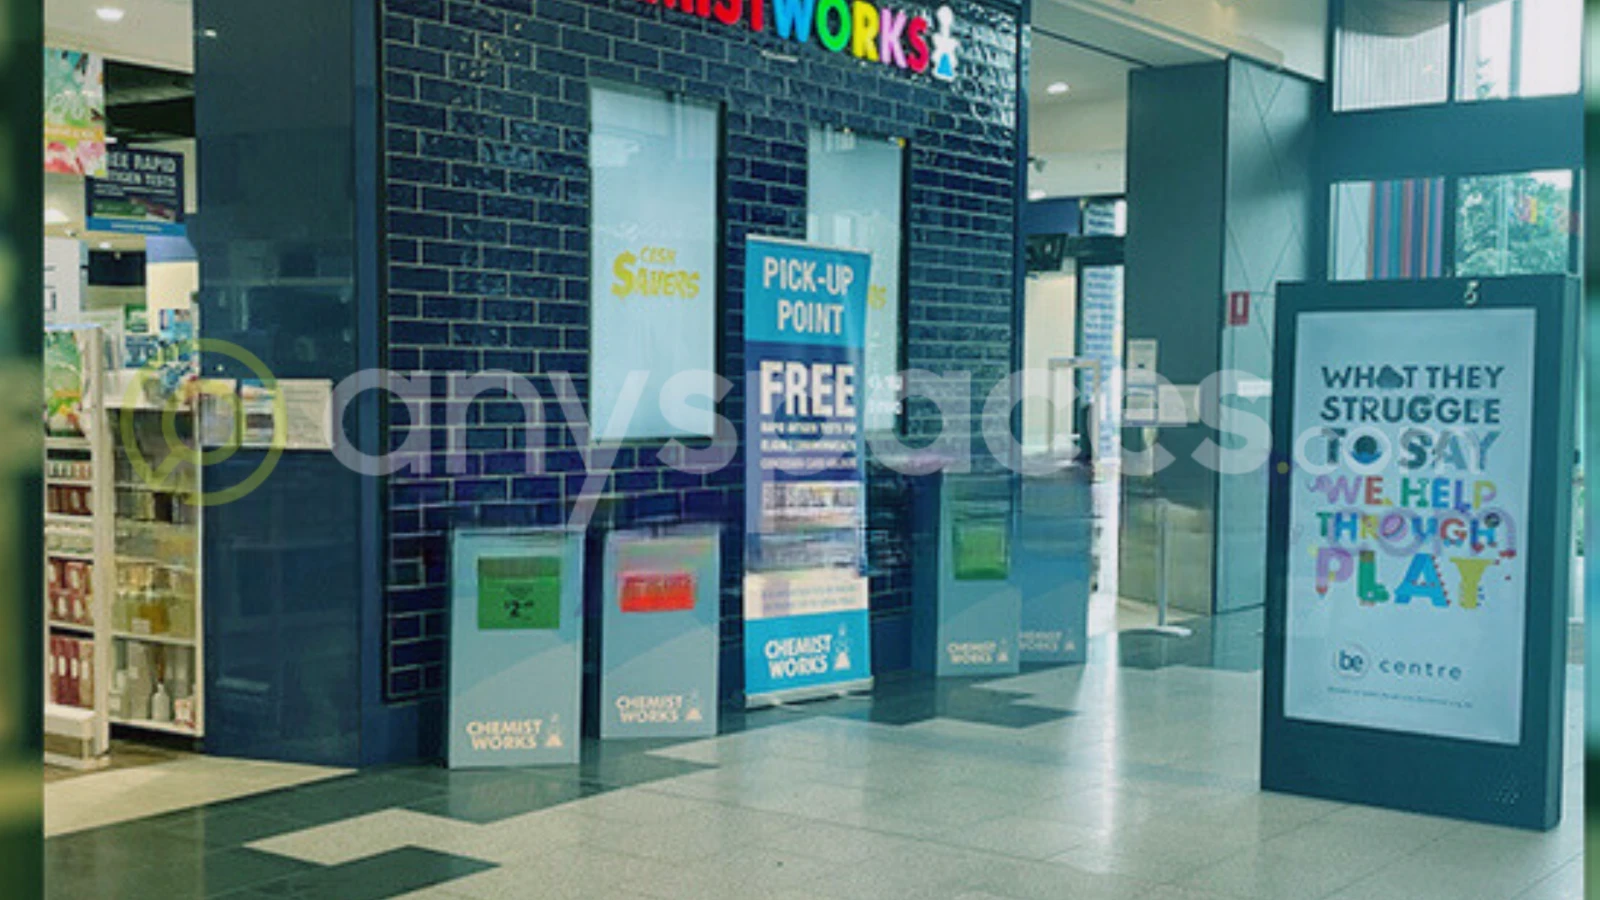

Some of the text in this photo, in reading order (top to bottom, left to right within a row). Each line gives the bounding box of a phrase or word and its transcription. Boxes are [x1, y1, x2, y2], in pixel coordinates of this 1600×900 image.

[762, 255, 854, 296] PICK-UP
[776, 299, 845, 336] POINT
[759, 360, 857, 418] FREE
[1320, 363, 1505, 390] WHAT THEY
[1320, 394, 1501, 424] STRUGGLE
[1320, 427, 1500, 471] TO SAY
[1401, 477, 1497, 512] HELP
[1316, 510, 1501, 552] THROUGH
[1314, 546, 1497, 610] PLAY
[765, 634, 833, 660] CHEMIST
[769, 654, 828, 679] WORKS
[1378, 659, 1462, 682] centre
[615, 694, 683, 712] CHEMIST
[620, 706, 679, 724] WORKS
[466, 719, 543, 736] CHEMIST
[471, 732, 537, 751] WORKS
